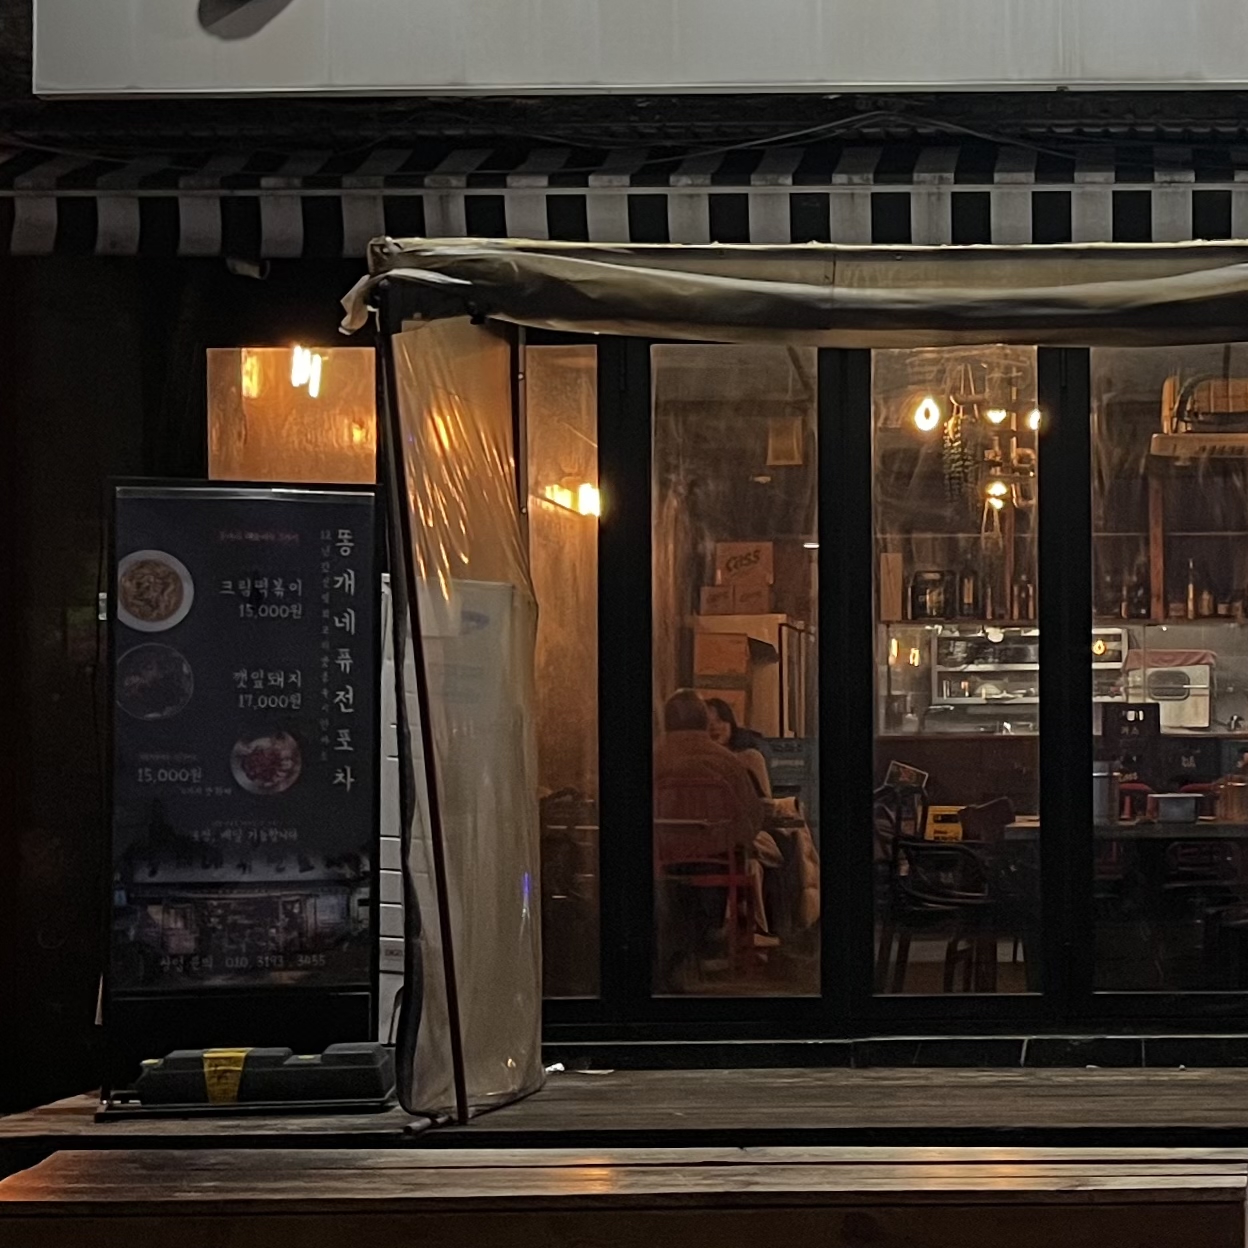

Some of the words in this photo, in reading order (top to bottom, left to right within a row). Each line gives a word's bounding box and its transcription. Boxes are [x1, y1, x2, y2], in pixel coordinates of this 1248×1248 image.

[219, 577, 302, 599] 크림떡볶이
[238, 602, 302, 620] 15,000원
[232, 668, 302, 689] 깻잎돼지
[238, 692, 302, 711] 17,000원
[137, 766, 202, 784] 15,000원
